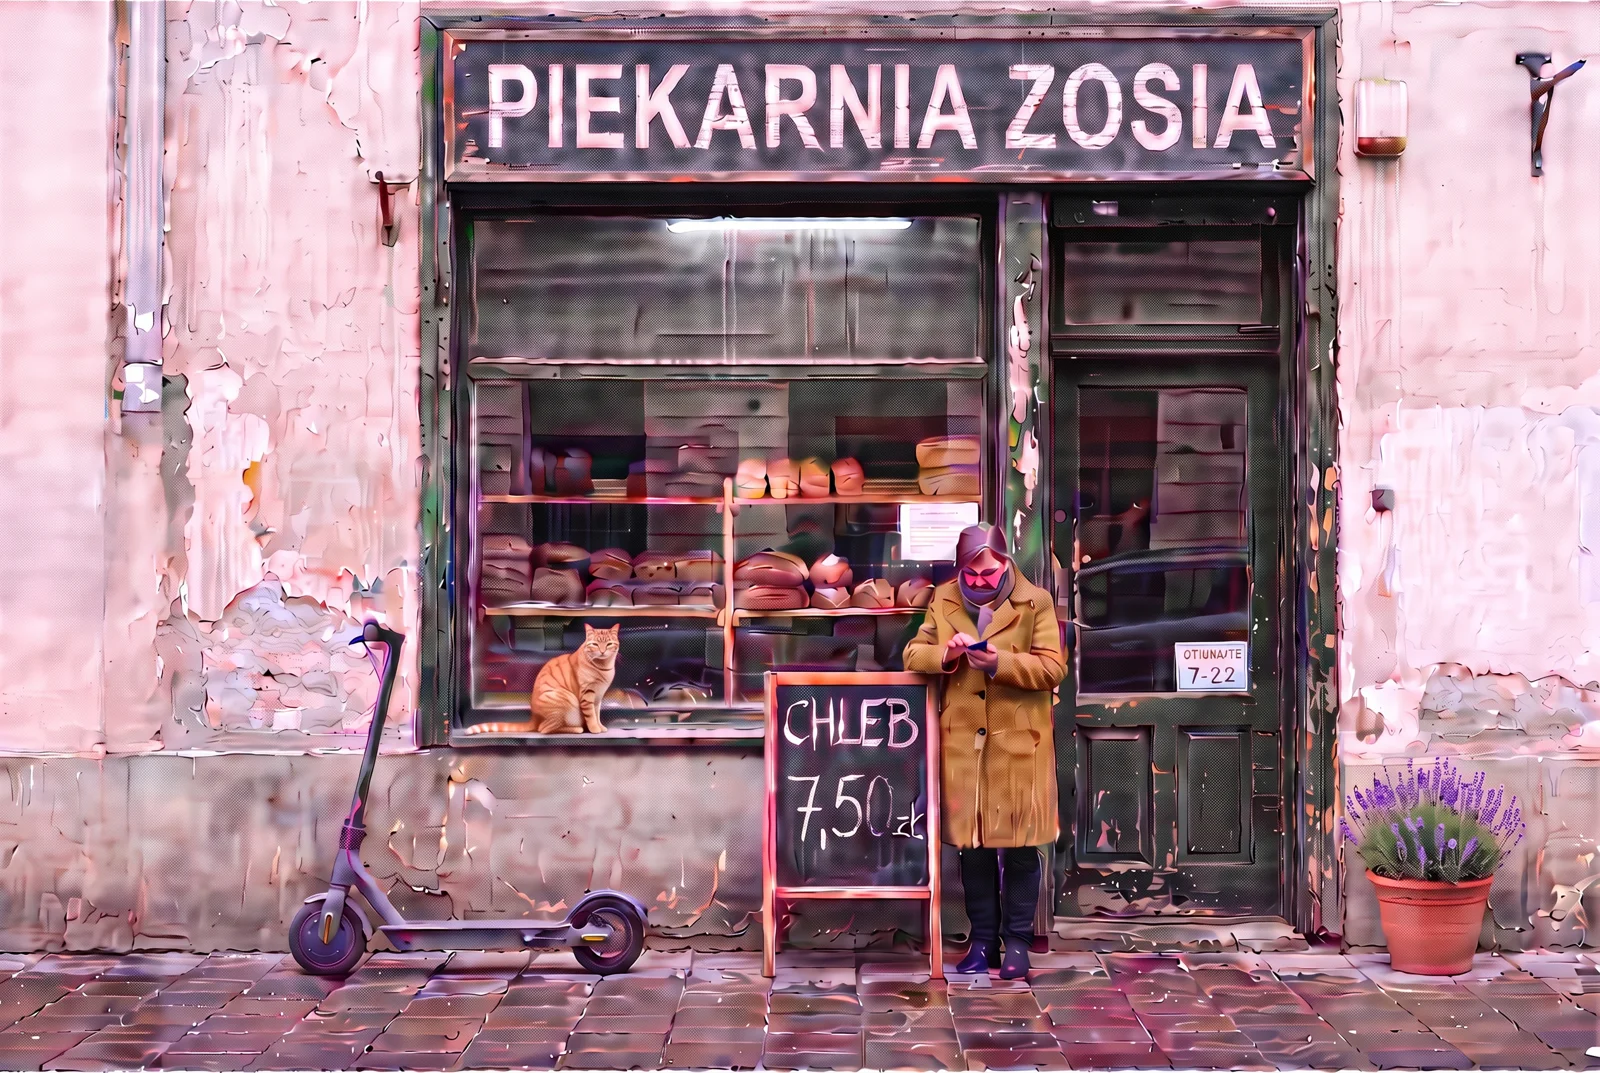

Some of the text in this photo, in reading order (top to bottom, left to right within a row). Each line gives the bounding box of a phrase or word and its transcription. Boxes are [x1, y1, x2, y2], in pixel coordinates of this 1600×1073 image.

[488, 62, 1277, 152] PIEKARNIA ZOSIA
[1187, 666, 1236, 685] 7-22
[783, 696, 919, 751] CHLEB
[787, 774, 893, 851] 7,50
